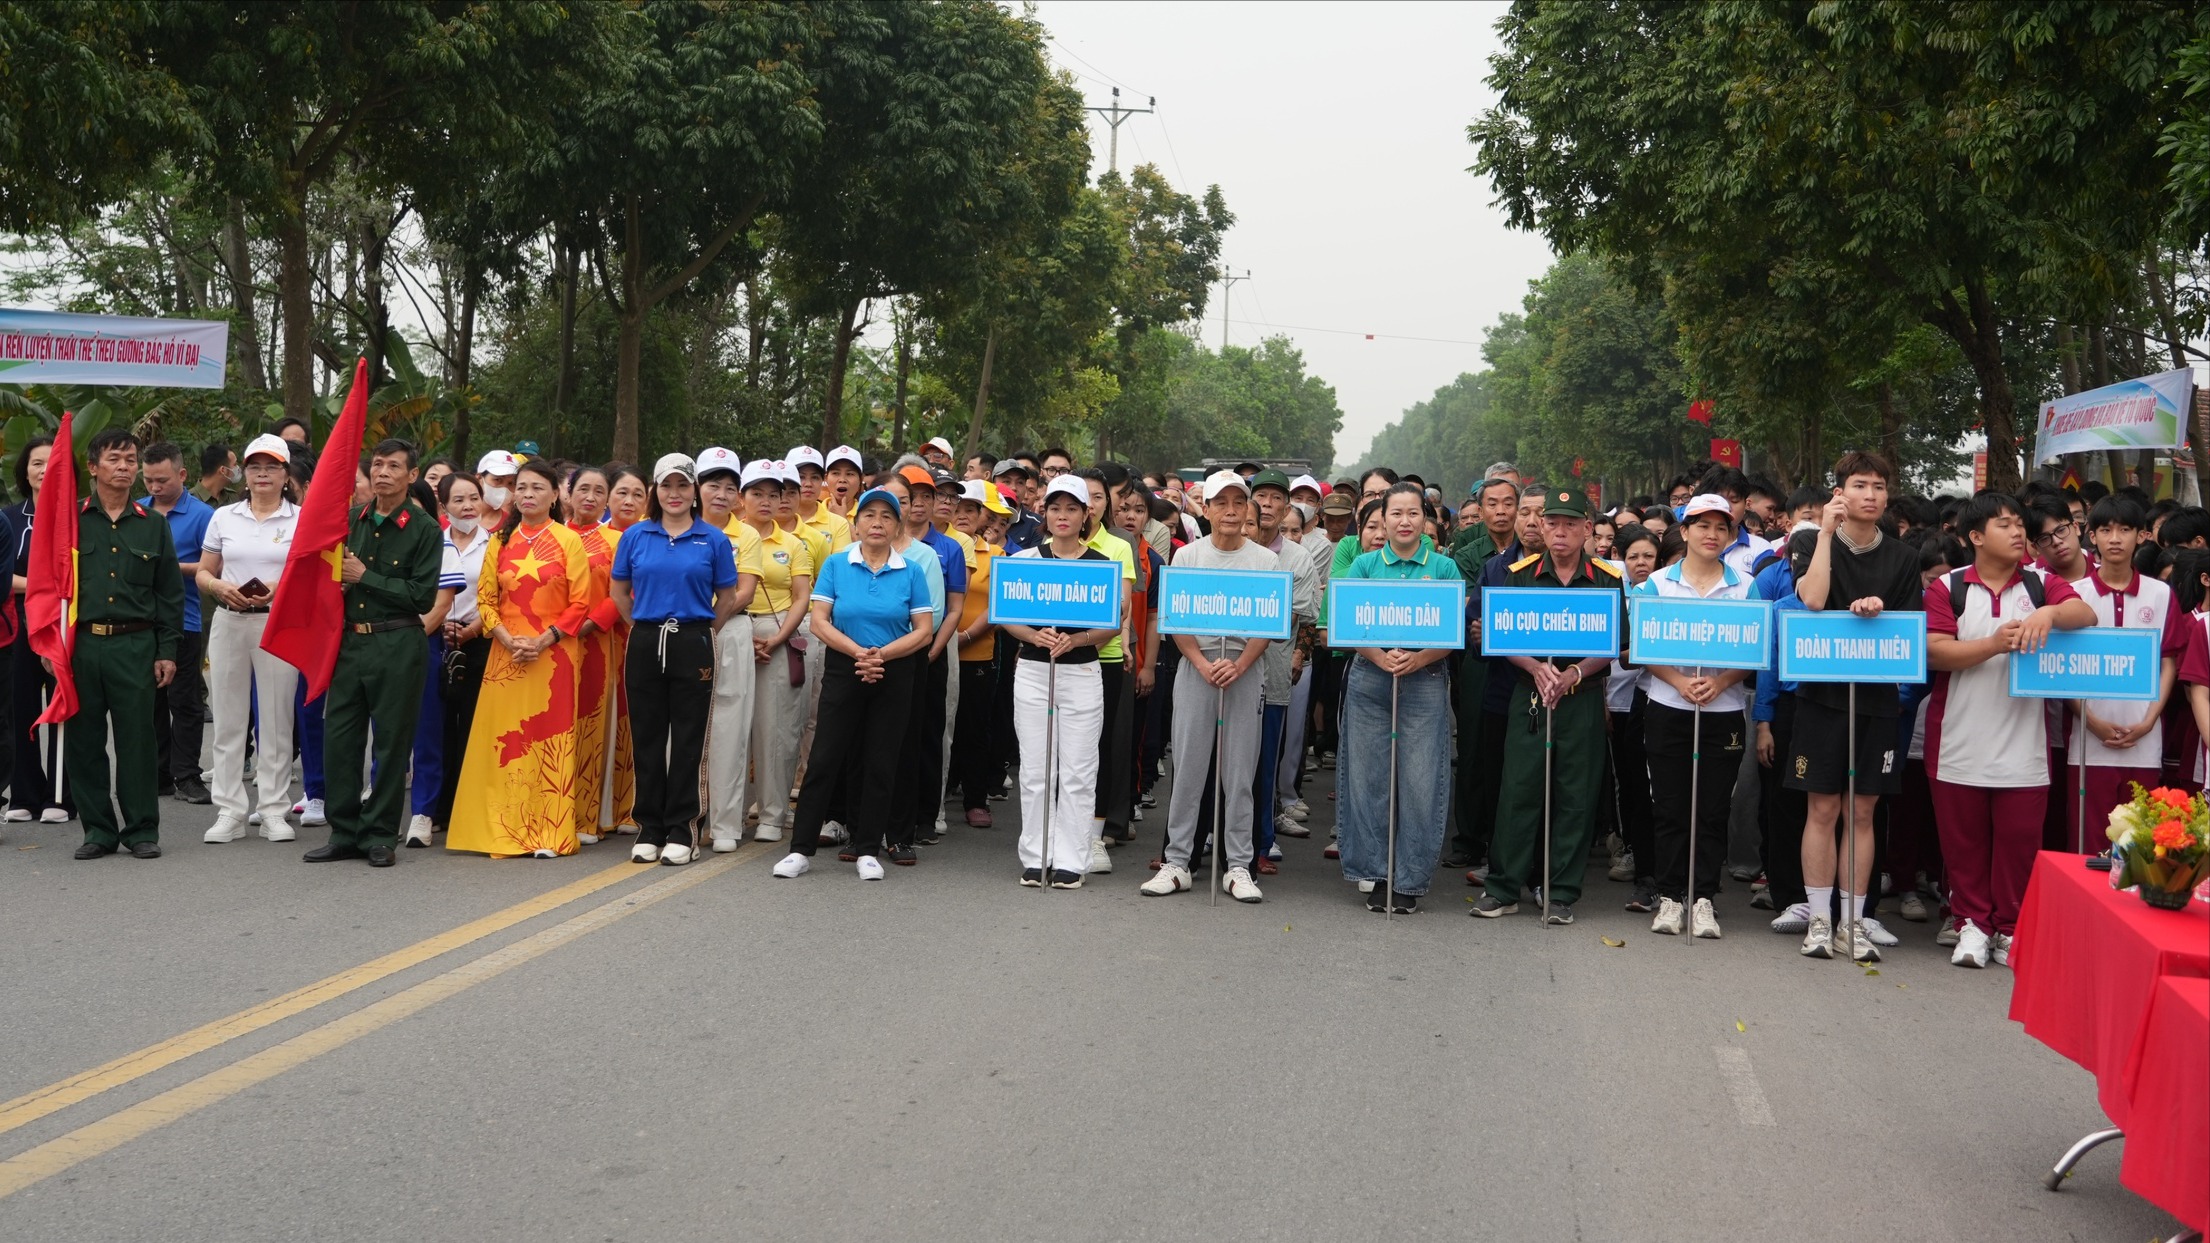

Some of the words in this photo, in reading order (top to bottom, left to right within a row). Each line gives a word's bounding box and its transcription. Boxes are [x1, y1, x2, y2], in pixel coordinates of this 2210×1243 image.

[25, 331, 53, 366] LUYỆN
[54, 333, 78, 361] THÂN
[95, 337, 115, 363] THEO
[117, 337, 144, 364] GƯƠNG
[145, 337, 162, 365] BÁC
[176, 339, 187, 366] VĨ
[185, 344, 200, 371] ĐẠI
[1003, 578, 1034, 602] THÔN,
[1037, 582, 1062, 605] CỤM
[1065, 580, 1088, 603] DÂN
[1091, 584, 1107, 604] CƯ
[1171, 590, 1190, 618] HỘI
[1193, 591, 1227, 616] NGƯỜI
[1229, 596, 1252, 617] CAO
[1255, 590, 1280, 618] TUỔI
[1355, 601, 1375, 630] HỘI
[1378, 601, 1412, 626] NÔNG
[1415, 602, 1440, 627] DÂN
[1494, 608, 1514, 635] HỘI
[1516, 610, 1539, 635] CỰU
[1542, 607, 1577, 632] CHIẾN
[1579, 613, 1607, 632] BINH
[1642, 617, 1660, 644] HỘI
[1662, 617, 1687, 641] LIÊN
[1689, 619, 1715, 646] HIỆP
[1717, 623, 1740, 648] PHỤ
[1742, 621, 1760, 644] NỮ
[1795, 633, 1831, 659] ĐOÀN
[1834, 638, 1876, 660] THANH
[1879, 634, 1911, 660] NIÊN
[2038, 652, 2065, 679] HỌC
[2068, 652, 2100, 676] SINH
[2103, 654, 2136, 677] THPT
[1881, 749, 1894, 774] 19
